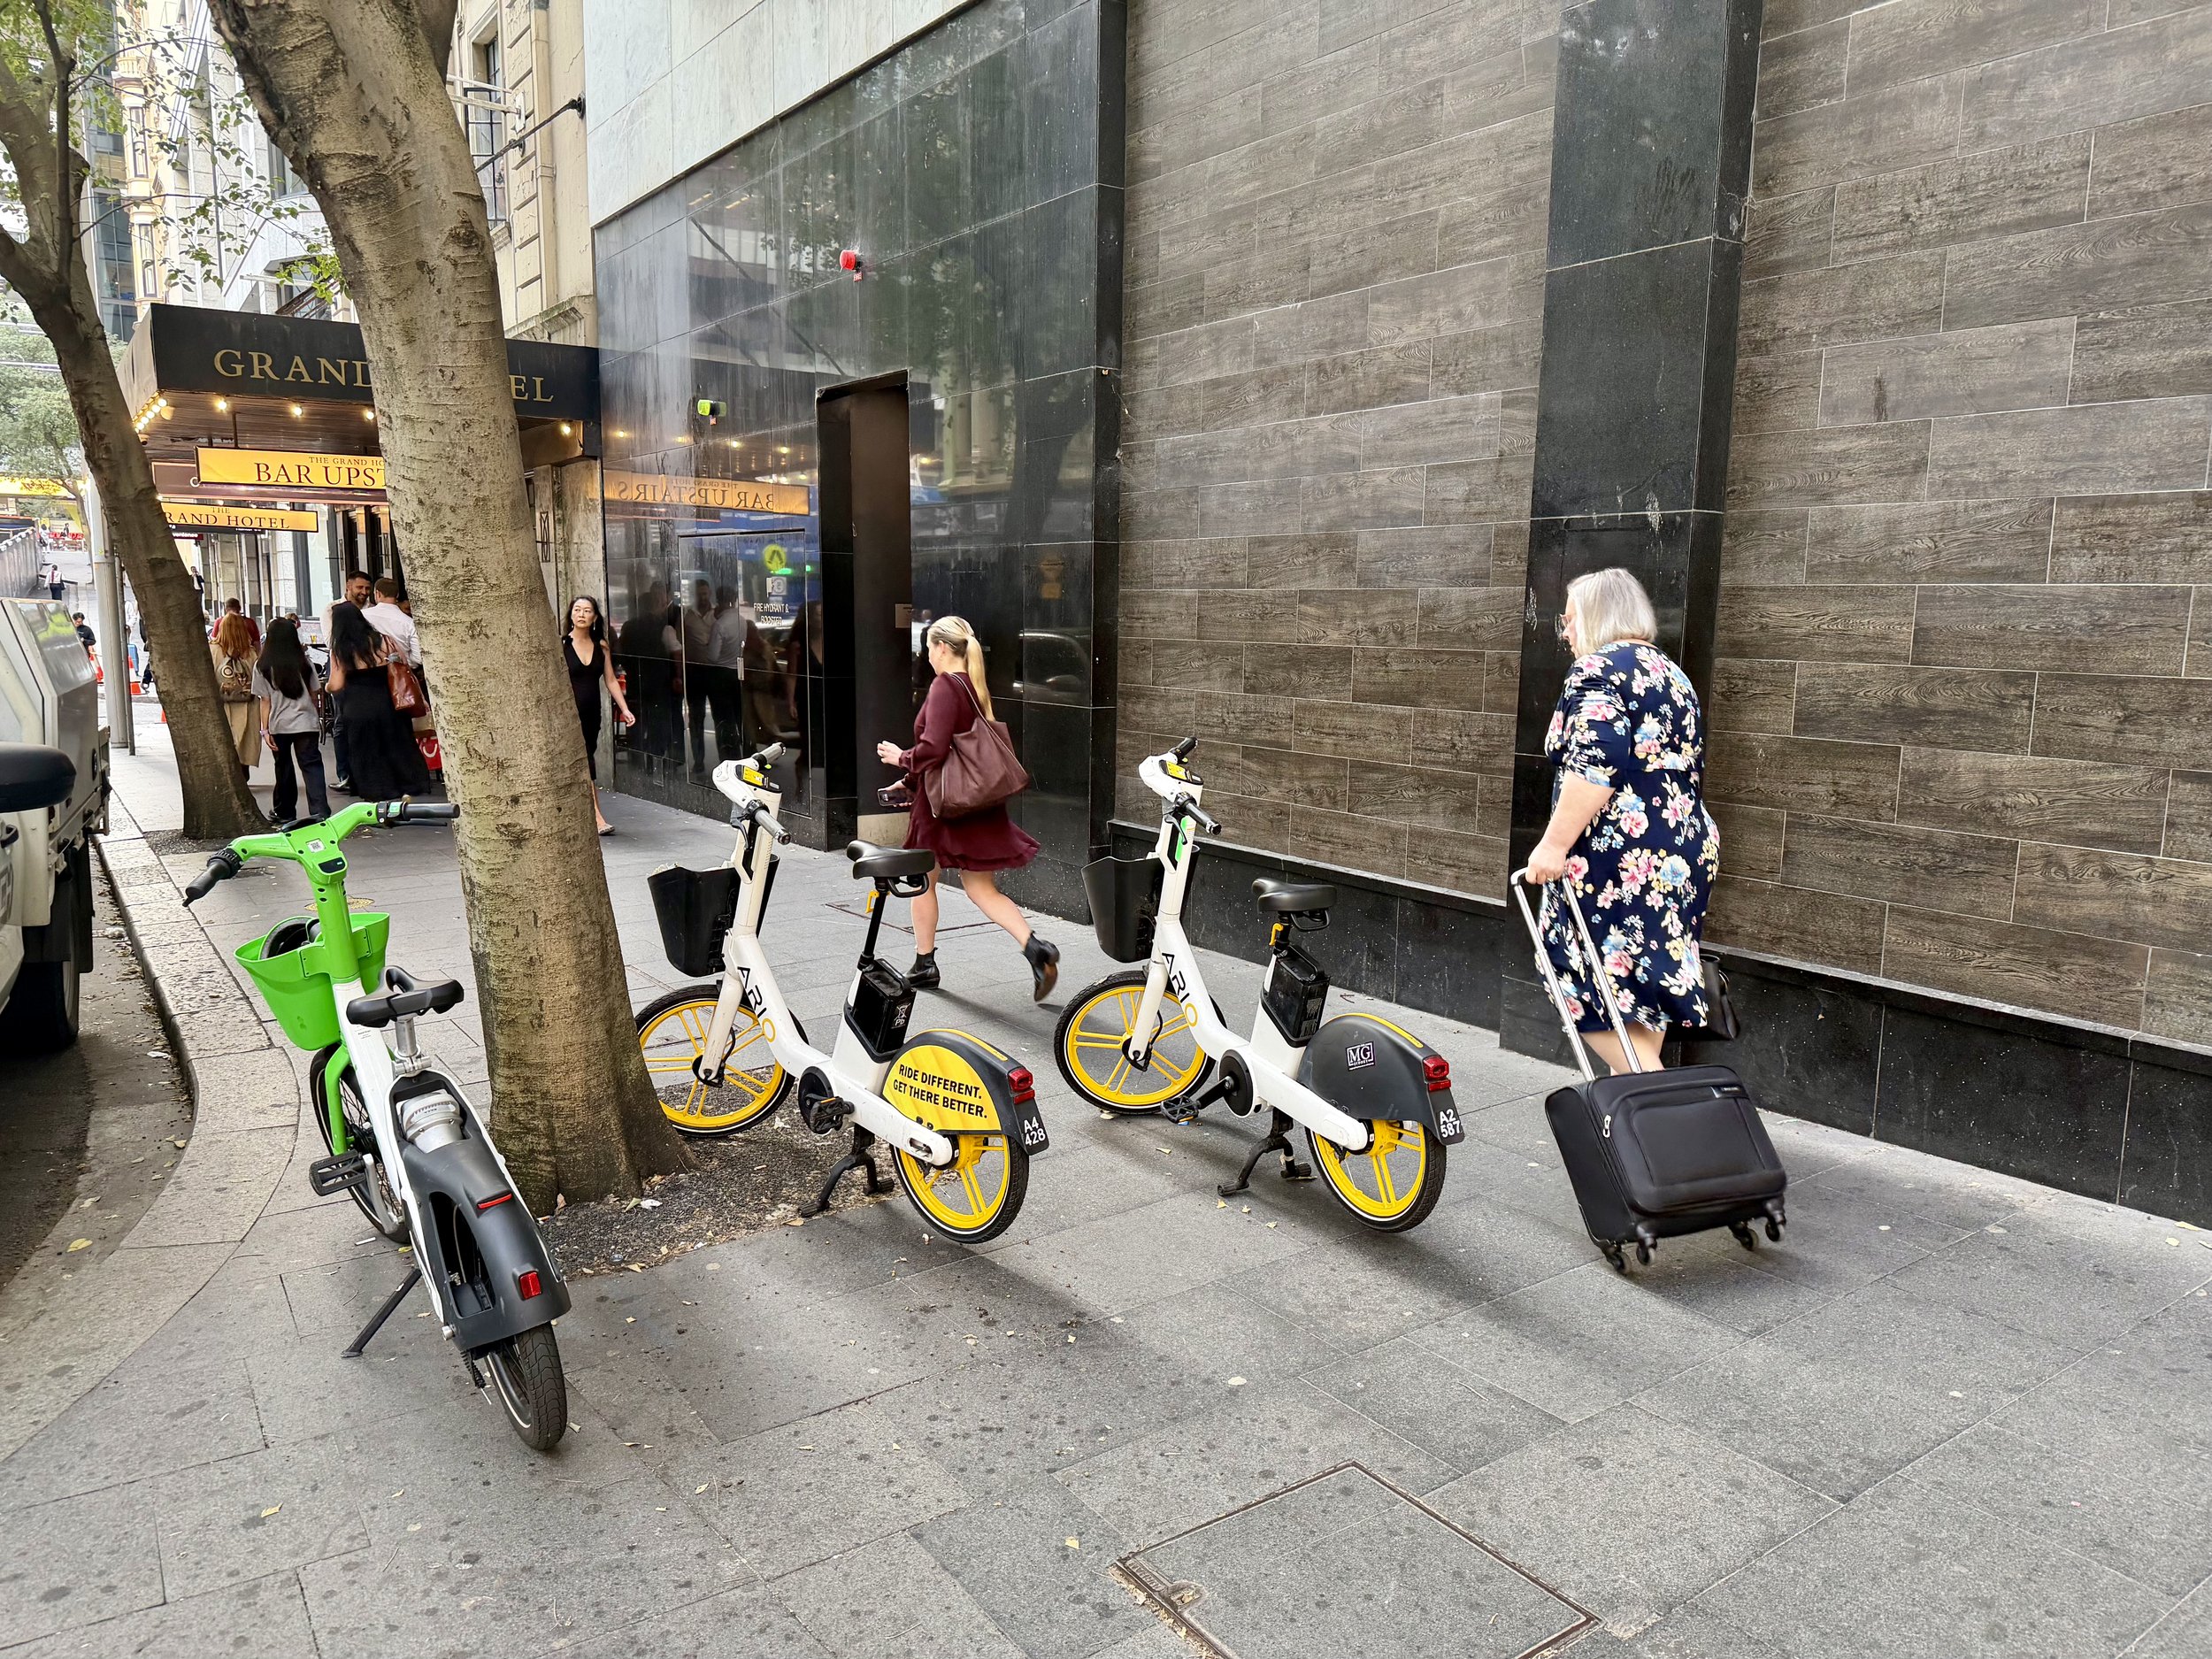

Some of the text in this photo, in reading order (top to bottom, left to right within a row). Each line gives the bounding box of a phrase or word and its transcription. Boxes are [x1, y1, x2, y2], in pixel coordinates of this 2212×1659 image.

[332, 457, 368, 466] GRAND
[254, 462, 315, 485] BAR
[165, 511, 290, 529] RAND HOTEL
[753, 603, 789, 613] FIRE HYDRANT &
[1162, 952, 1198, 1027] ARIO
[737, 966, 776, 1043] ARIO
[1349, 1046, 1371, 1063] MG
[898, 1064, 982, 1099] RIDE DIFFERENT.
[893, 1079, 987, 1118] GET THERE BETTER.
[1024, 1116, 1040, 1133] A4
[1439, 1109, 1456, 1125] A2
[1025, 1128, 1046, 1146] 428
[1440, 1119, 1461, 1138] 587
